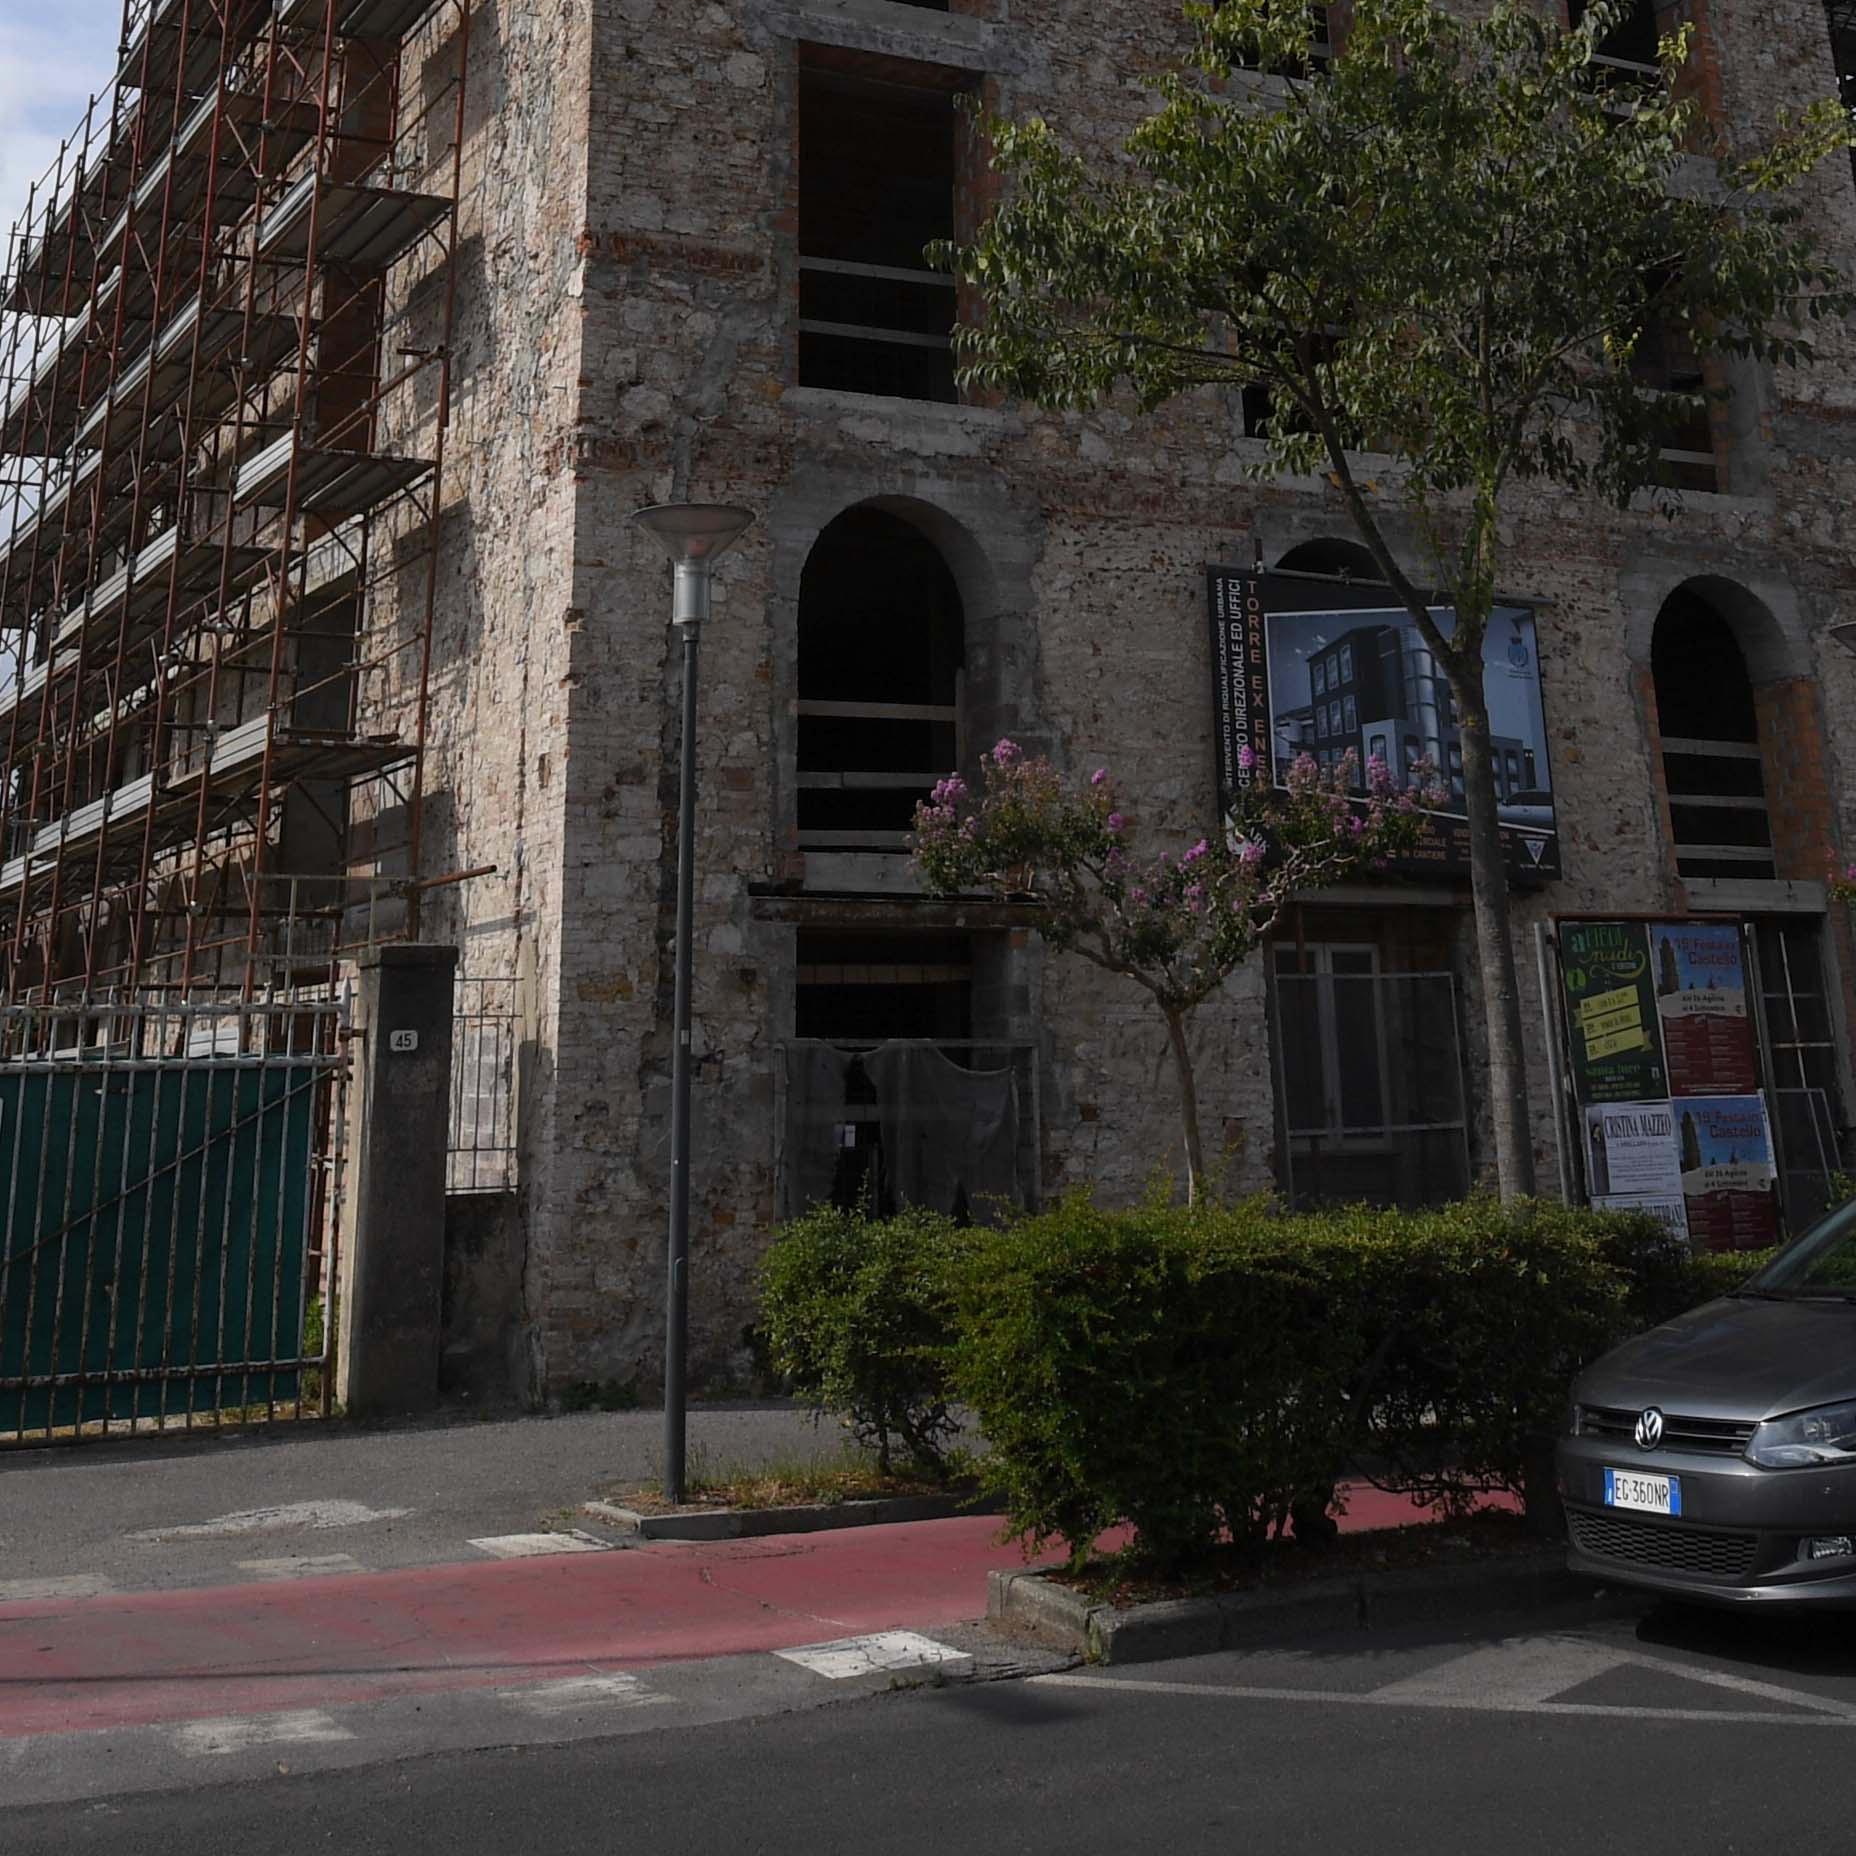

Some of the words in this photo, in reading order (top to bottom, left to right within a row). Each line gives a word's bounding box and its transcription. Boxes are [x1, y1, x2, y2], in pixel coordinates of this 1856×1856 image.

[1216, 577, 1225, 618] URBANA
[1228, 579, 1242, 620] UFFICI
[1230, 622, 1243, 641] ED
[1247, 580, 1262, 663] TORRE
[1218, 620, 1229, 710] RIQUALIFICAZIONE
[1231, 643, 1248, 730] DIREZIONALE
[1252, 675, 1264, 707] EX
[1223, 712, 1230, 723] DI
[395, 1033, 412, 1048] 45
[1605, 1115, 1638, 1139] CRISTINA
[1640, 1113, 1672, 1138] MAZZEO
[1632, 1480, 1669, 1507] 360NR
